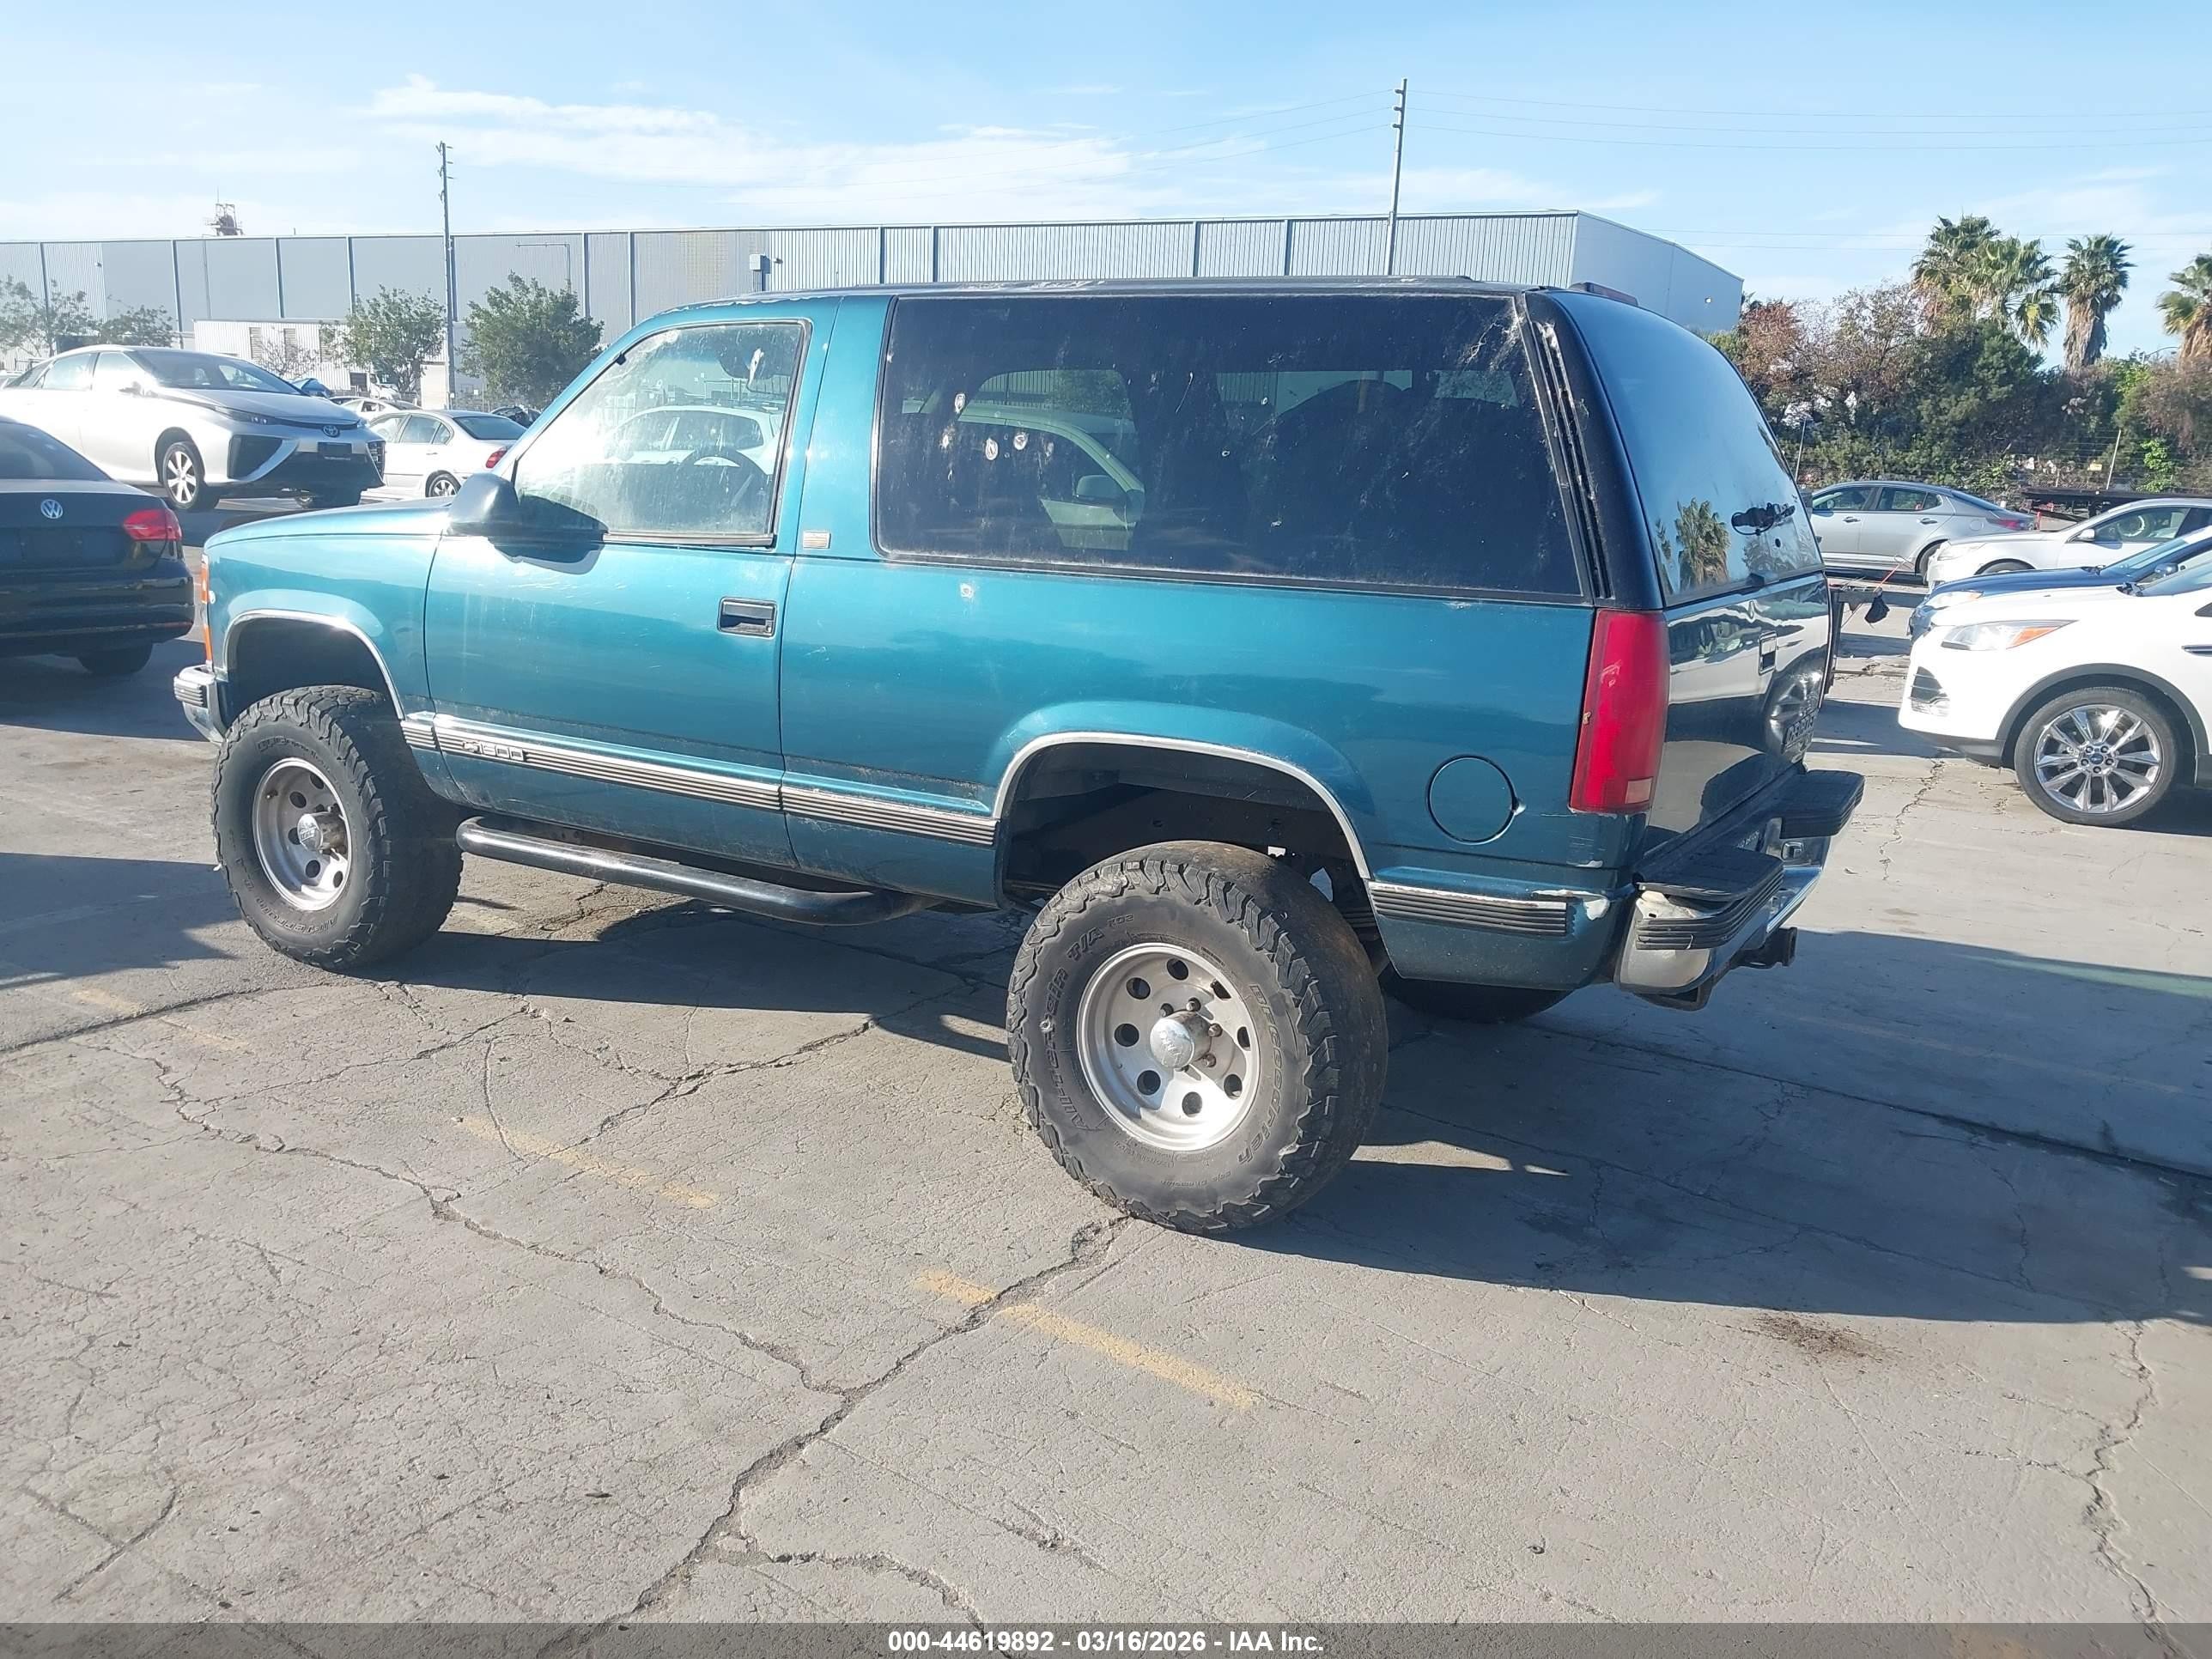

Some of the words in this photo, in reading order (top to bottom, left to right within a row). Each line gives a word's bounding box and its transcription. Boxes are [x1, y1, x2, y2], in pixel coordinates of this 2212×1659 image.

[41, 499, 64, 520] VW
[1066, 927, 1105, 963] T/A
[1238, 982, 1284, 1166] BFGoodrich
